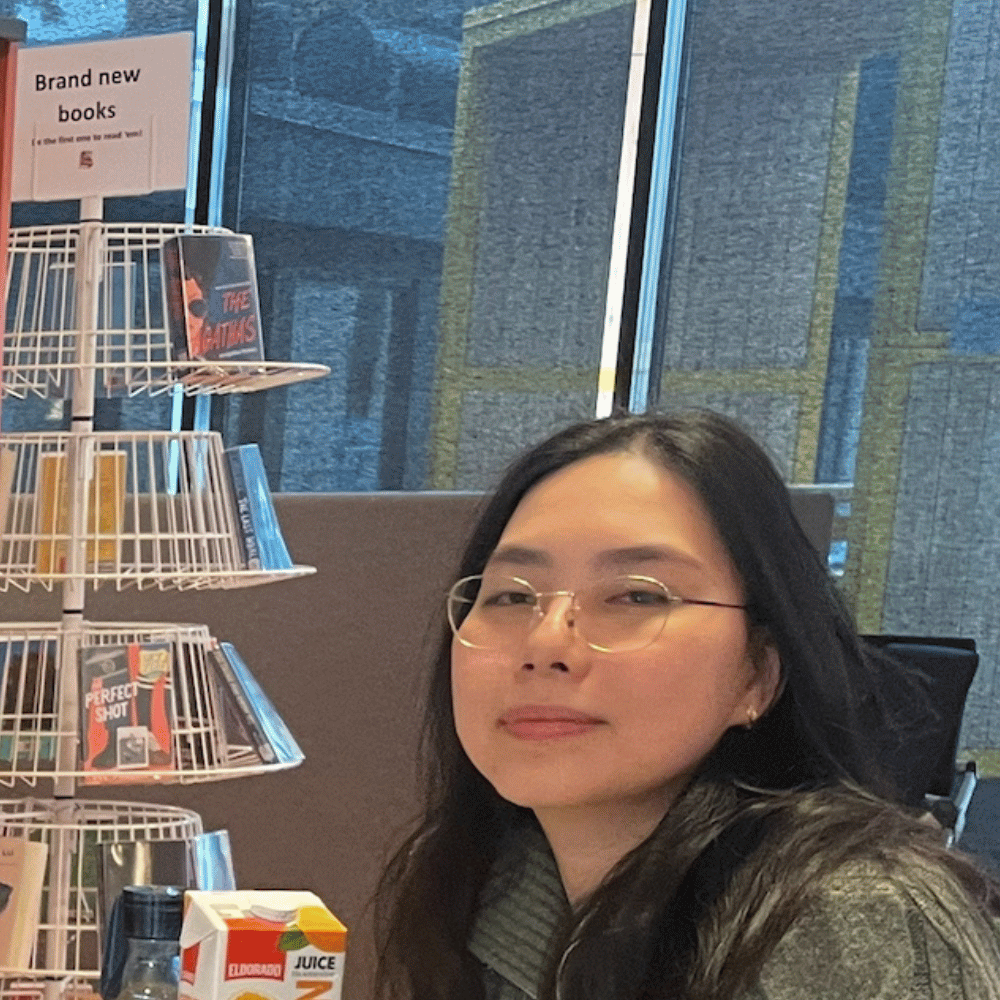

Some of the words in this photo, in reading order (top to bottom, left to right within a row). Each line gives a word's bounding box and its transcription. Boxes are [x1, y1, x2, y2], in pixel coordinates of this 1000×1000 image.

[35, 68, 92, 92] Brand
[99, 68, 141, 86] new
[58, 101, 116, 123] books
[221, 288, 251, 314] THE
[85, 682, 140, 709] PERFECT
[95, 701, 129, 723] SHOT
[228, 963, 282, 977] ELDORADO
[294, 956, 336, 970] JUICE
